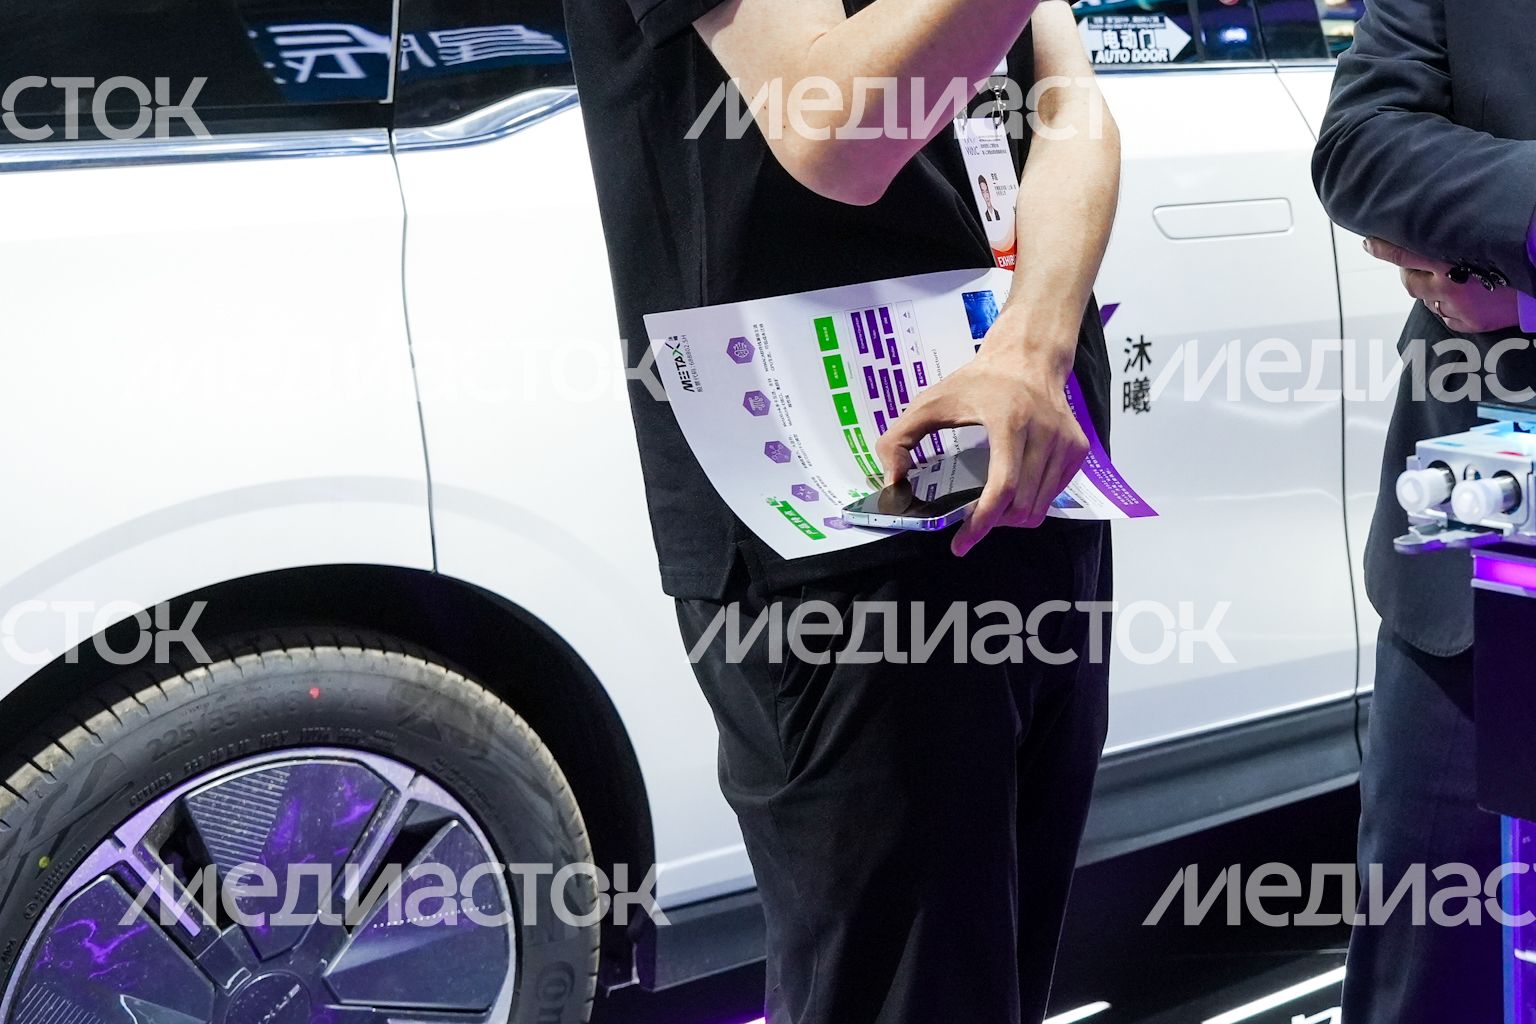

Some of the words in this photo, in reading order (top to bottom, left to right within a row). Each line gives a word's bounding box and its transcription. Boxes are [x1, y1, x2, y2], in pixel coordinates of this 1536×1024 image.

[1095, 49, 1131, 64] AUTO
[1131, 48, 1169, 64] DOOR
[1102, 29, 1157, 50] 电动门
[665, 342, 695, 393] METAX
[1123, 334, 1152, 414] 沐曦
